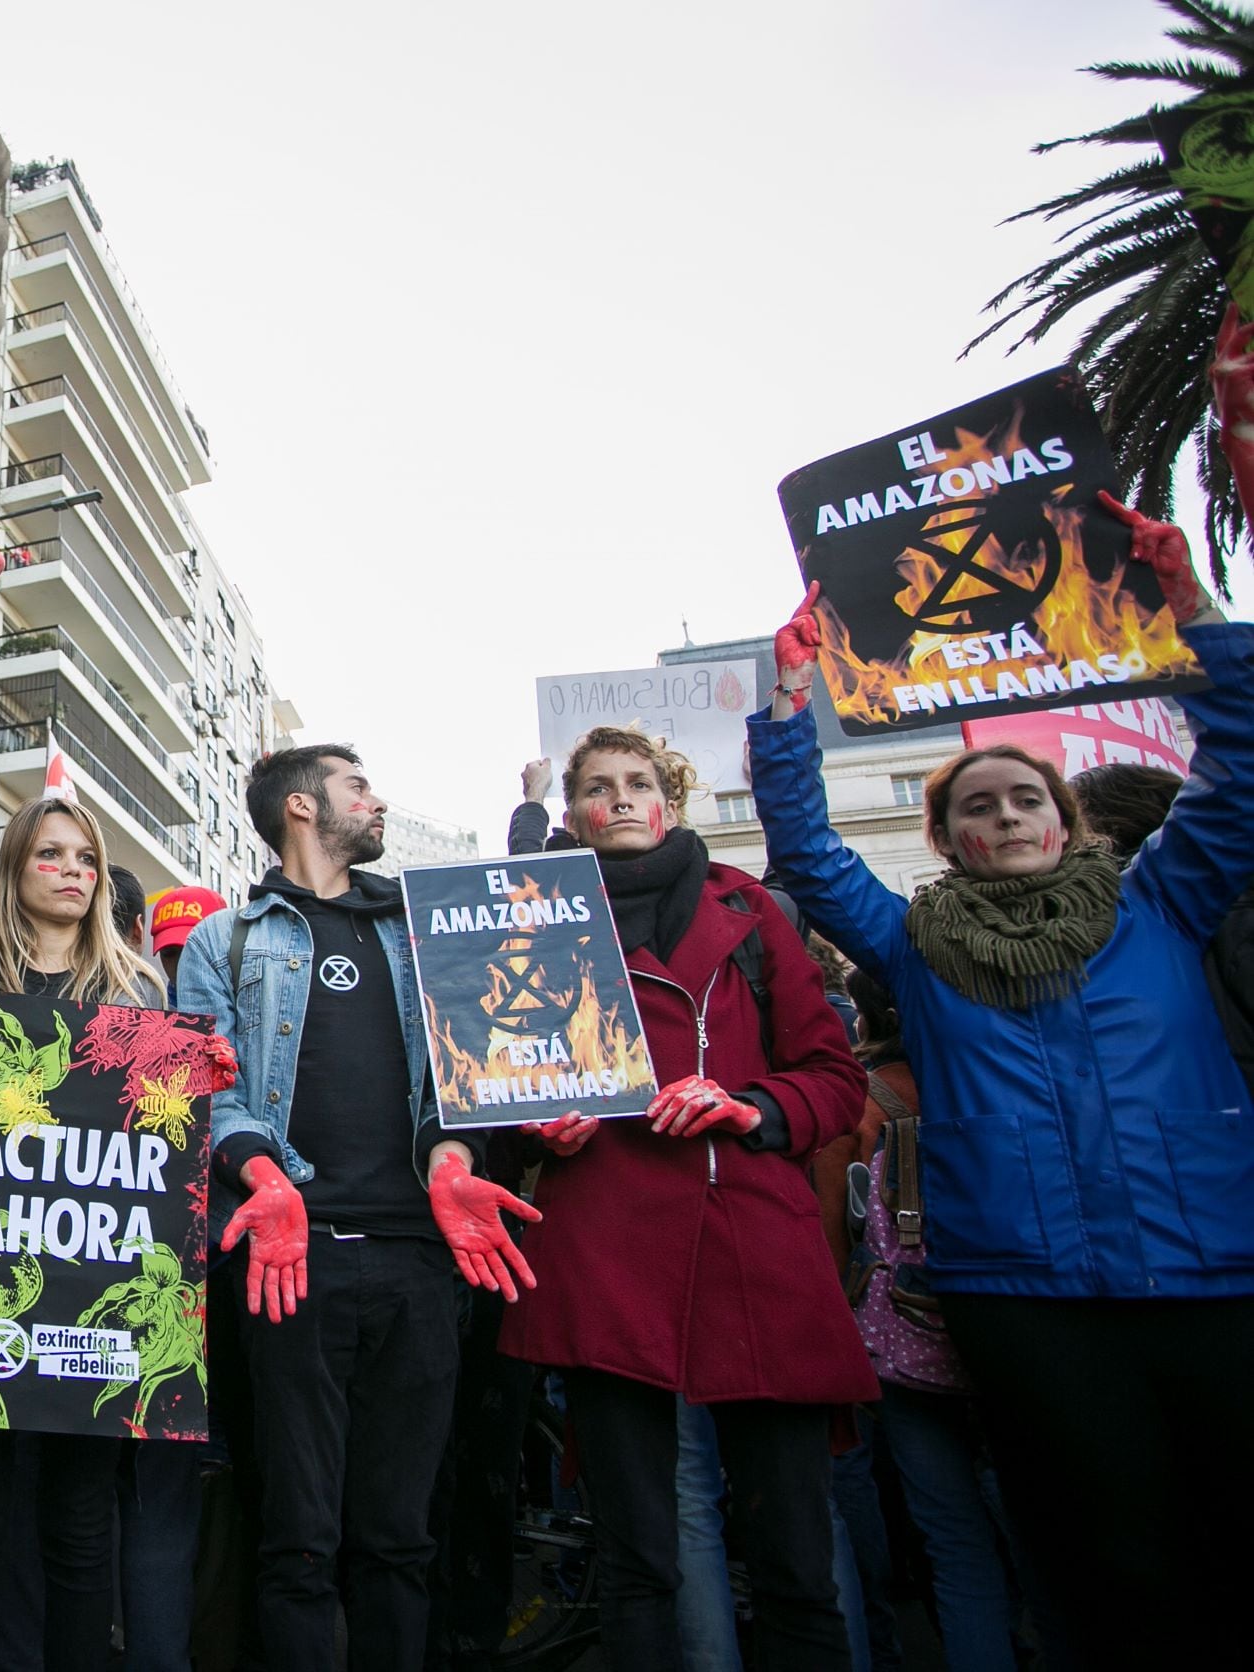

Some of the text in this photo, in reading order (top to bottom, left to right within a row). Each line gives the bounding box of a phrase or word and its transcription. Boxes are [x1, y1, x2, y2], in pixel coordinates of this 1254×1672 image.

[898, 431, 947, 470] EL
[815, 437, 1074, 535] AMAZONAS
[940, 622, 1044, 669] ESTÁ
[485, 869, 516, 895] EL
[154, 901, 184, 926] JCR
[430, 895, 591, 935] AMAZONAS
[507, 1032, 570, 1067] ESTÁ
[37, 1328, 117, 1352] extinction
[61, 1353, 135, 1377] rebellion
